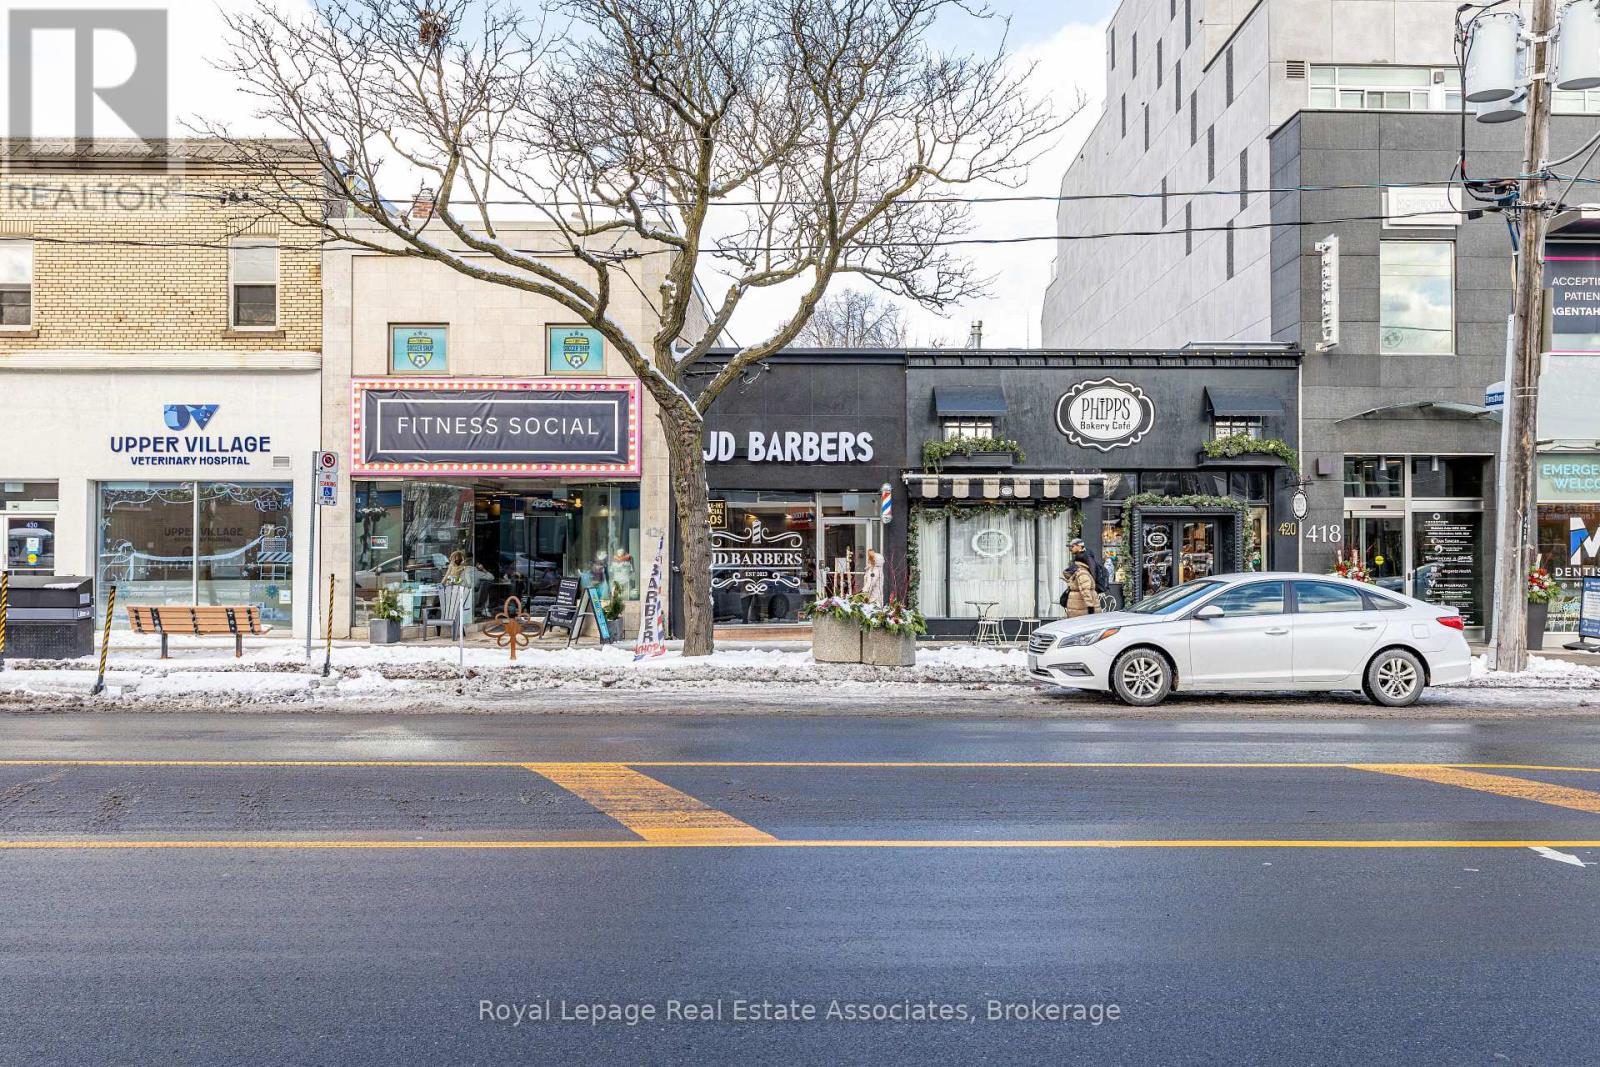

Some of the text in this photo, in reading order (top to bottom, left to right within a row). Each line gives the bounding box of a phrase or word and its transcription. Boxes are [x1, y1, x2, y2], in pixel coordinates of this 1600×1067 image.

[1551, 276, 1600, 286] ACCEPTI
[1081, 397, 1131, 421] PHIPPS
[398, 416, 600, 435] FITNESS SOCIAL
[1080, 421, 1110, 431] Bakery
[110, 436, 271, 453] UPPER VILLAGE
[747, 431, 874, 462] BARBERS
[131, 456, 251, 465] VETERINARY HOSPITAL
[164, 527, 197, 536] UPPE
[1278, 522, 1297, 536] 420
[1305, 524, 1342, 543] 418
[731, 552, 802, 565] BARBERS
